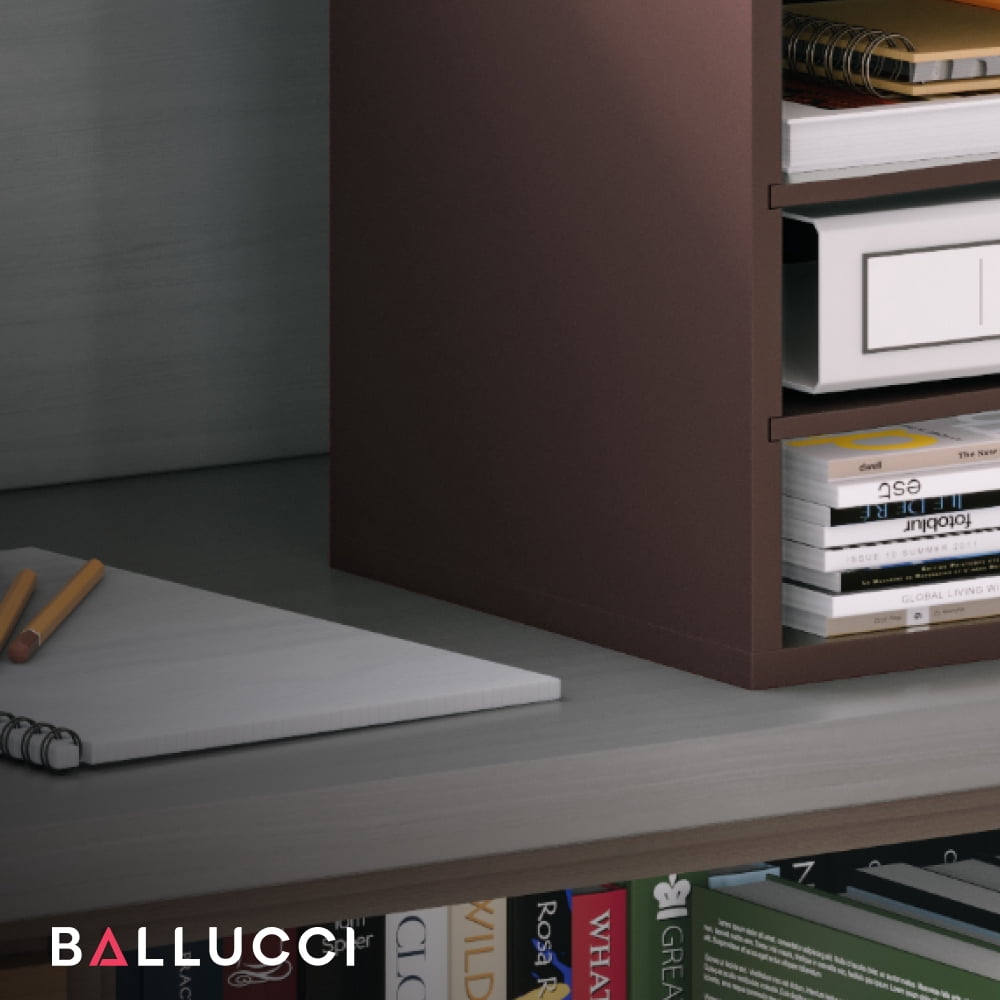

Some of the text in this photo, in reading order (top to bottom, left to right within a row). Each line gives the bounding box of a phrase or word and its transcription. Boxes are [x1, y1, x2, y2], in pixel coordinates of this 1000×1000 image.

[877, 478, 922, 500] est
[903, 511, 972, 533] fotoblur
[901, 589, 944, 605] GLOBAL
[947, 585, 985, 600] LIVING
[534, 900, 558, 966] Rosa
